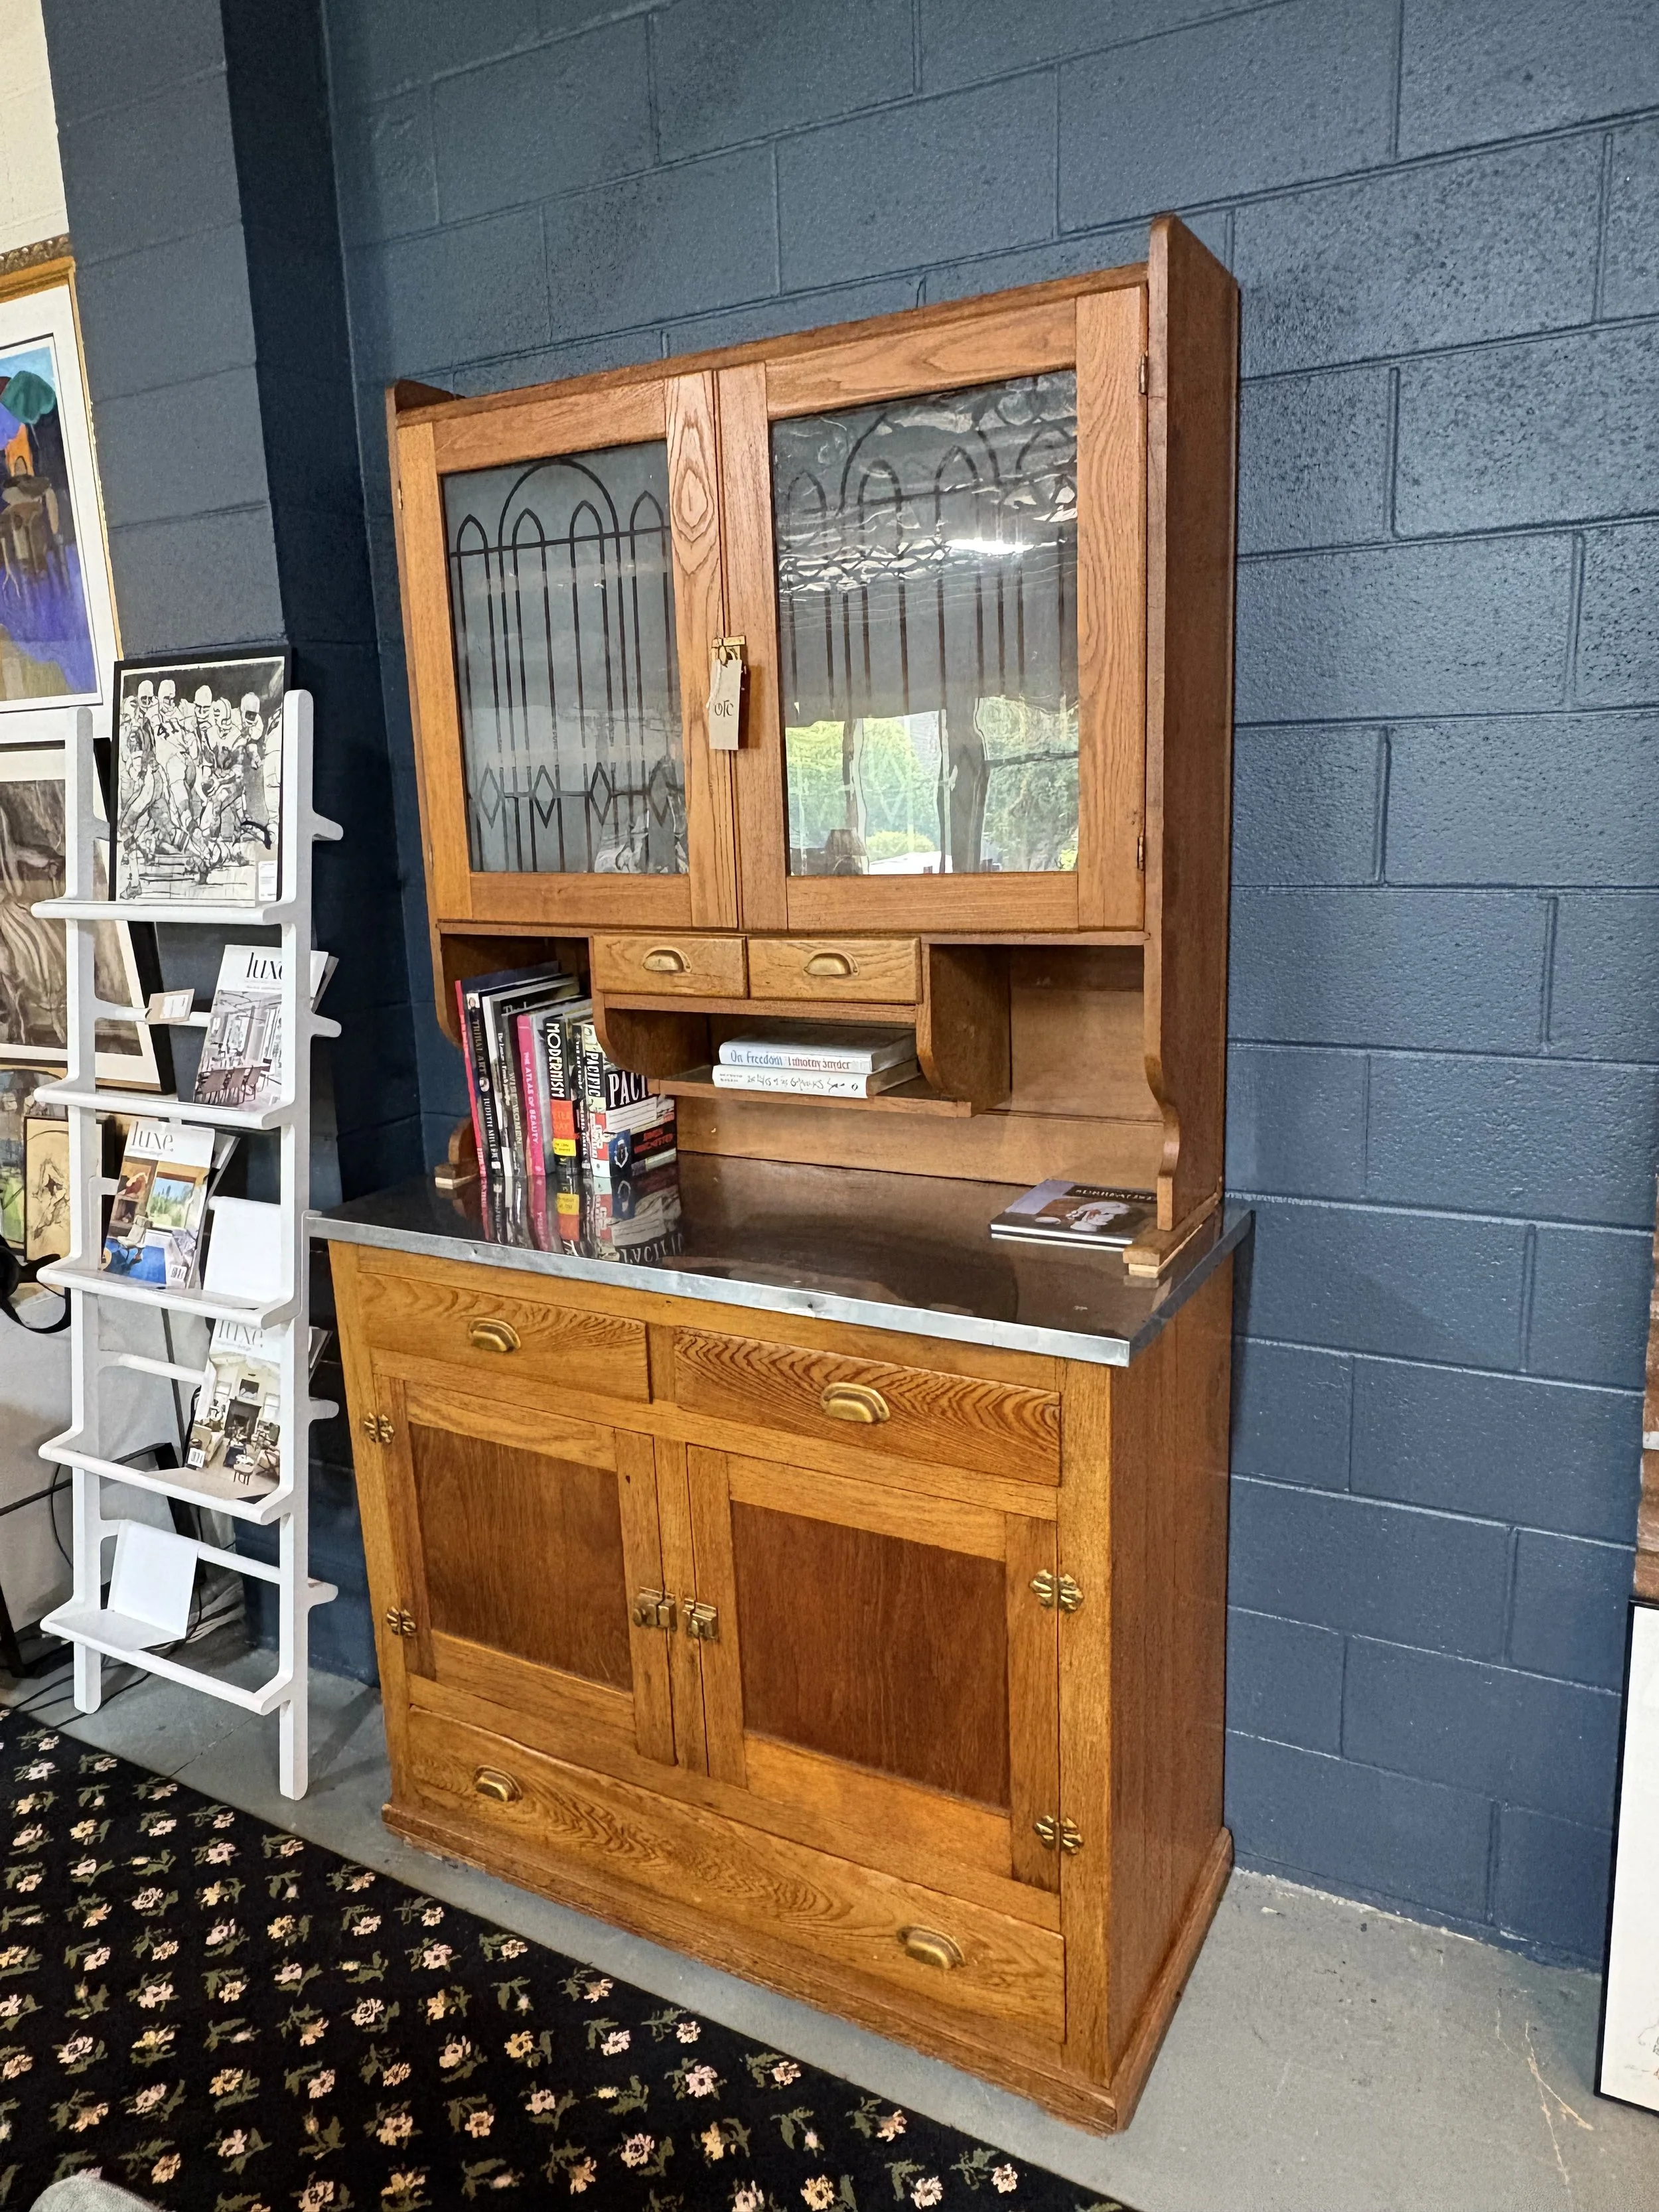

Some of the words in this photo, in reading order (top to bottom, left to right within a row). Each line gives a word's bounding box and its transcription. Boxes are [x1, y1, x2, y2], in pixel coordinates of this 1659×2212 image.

[545, 1023, 565, 1098] MODERNISM
[585, 1051, 601, 1097] PACIFIC
[731, 1049, 744, 1063] On
[747, 1051, 783, 1066] Freedom
[477, 1055, 488, 1075] ART
[483, 1098, 493, 1128] JUDITH
[488, 1130, 499, 1159] MILLER
[524, 1067, 534, 1094] ATLAS
[529, 1108, 540, 1145] BEAUTY
[607, 1070, 652, 1108] PACI
[512, 1104, 523, 1145] WOMEN
